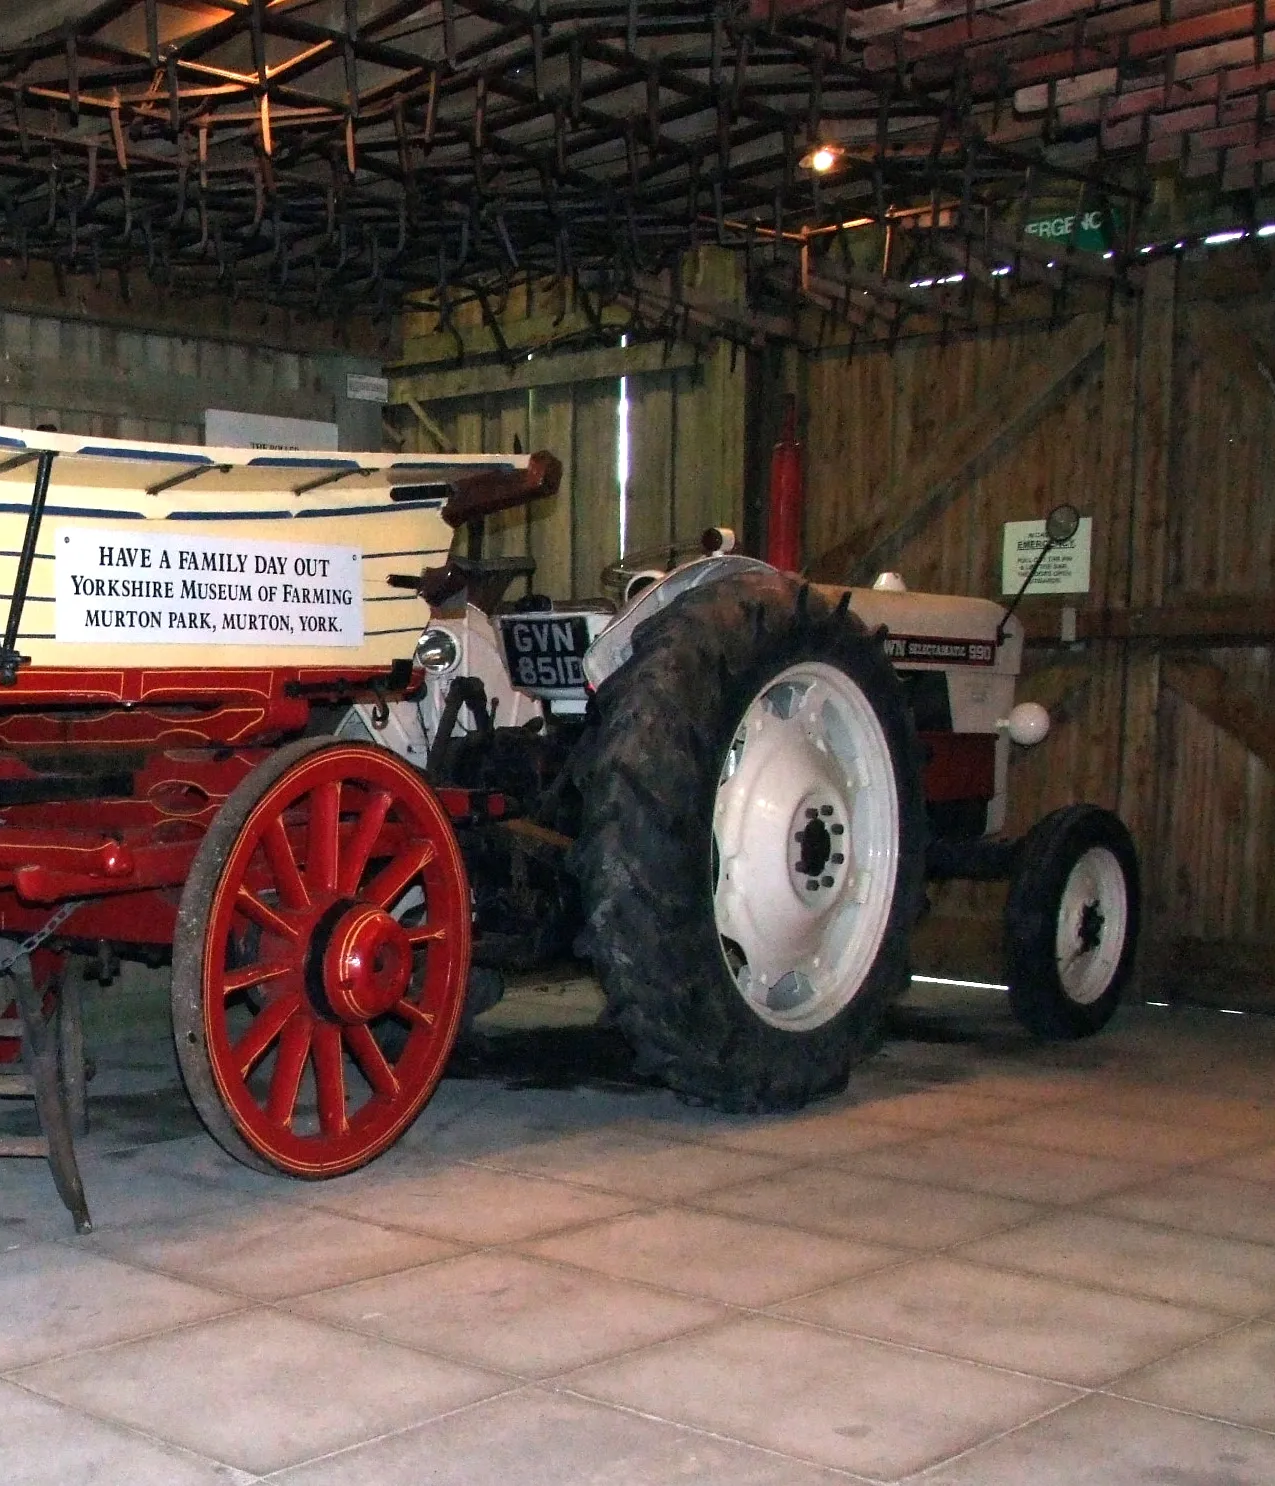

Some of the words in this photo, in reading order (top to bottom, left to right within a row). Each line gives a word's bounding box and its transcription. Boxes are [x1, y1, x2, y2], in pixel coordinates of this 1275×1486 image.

[98, 546, 152, 569] HAVE
[159, 549, 171, 570] A
[178, 551, 248, 574] FAMILY
[254, 555, 287, 576] DAY
[294, 557, 330, 578] OUT
[71, 574, 174, 599] YORKSHIRE
[180, 579, 252, 602] MUSEUM
[258, 585, 278, 602] OF
[282, 584, 353, 606] FARMING
[84, 609, 162, 629] MURTON
[168, 612, 217, 632] PARK,
[222, 613, 294, 634] MURTON,
[299, 615, 343, 633] YORK.
[513, 622, 574, 652] GVN
[968, 644, 991, 661] 990
[517, 656, 585, 684] 851D
